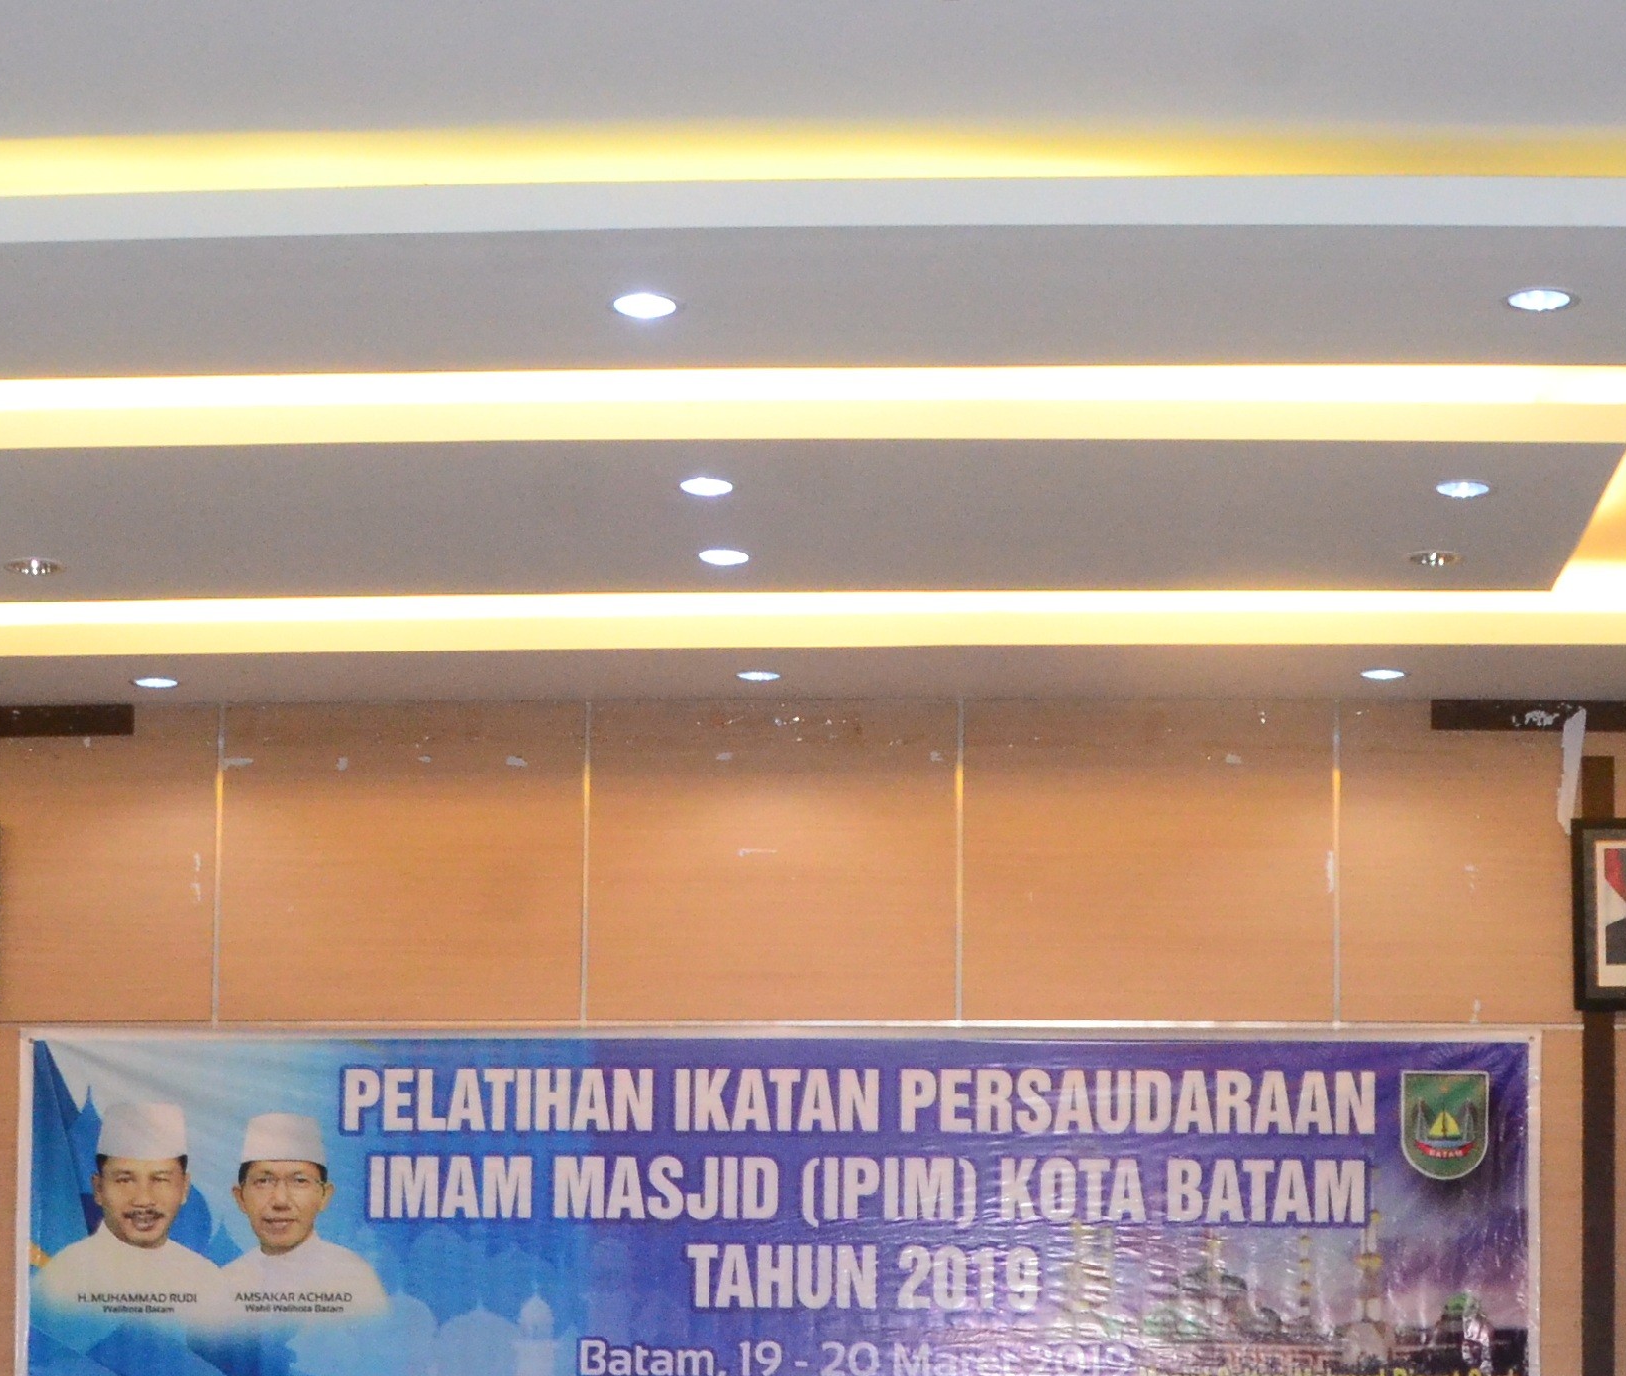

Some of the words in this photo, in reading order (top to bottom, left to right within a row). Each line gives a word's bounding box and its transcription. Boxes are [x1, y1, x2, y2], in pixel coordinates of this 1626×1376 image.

[342, 1069, 654, 1132] PELATIHAN
[674, 1069, 878, 1133] IKATAN
[900, 1069, 1375, 1135] PERSAUDARAAN
[369, 1156, 531, 1219] IMAM
[553, 1156, 778, 1220] MASJID
[802, 1157, 977, 1228] (IPIM)
[1000, 1159, 1147, 1223] KOTA
[1165, 1159, 1365, 1224] BATAM
[688, 1244, 875, 1309] TAHUN
[898, 1246, 1040, 1310] 2019
[739, 1341, 783, 1376] 19
[820, 1341, 880, 1376] 20
